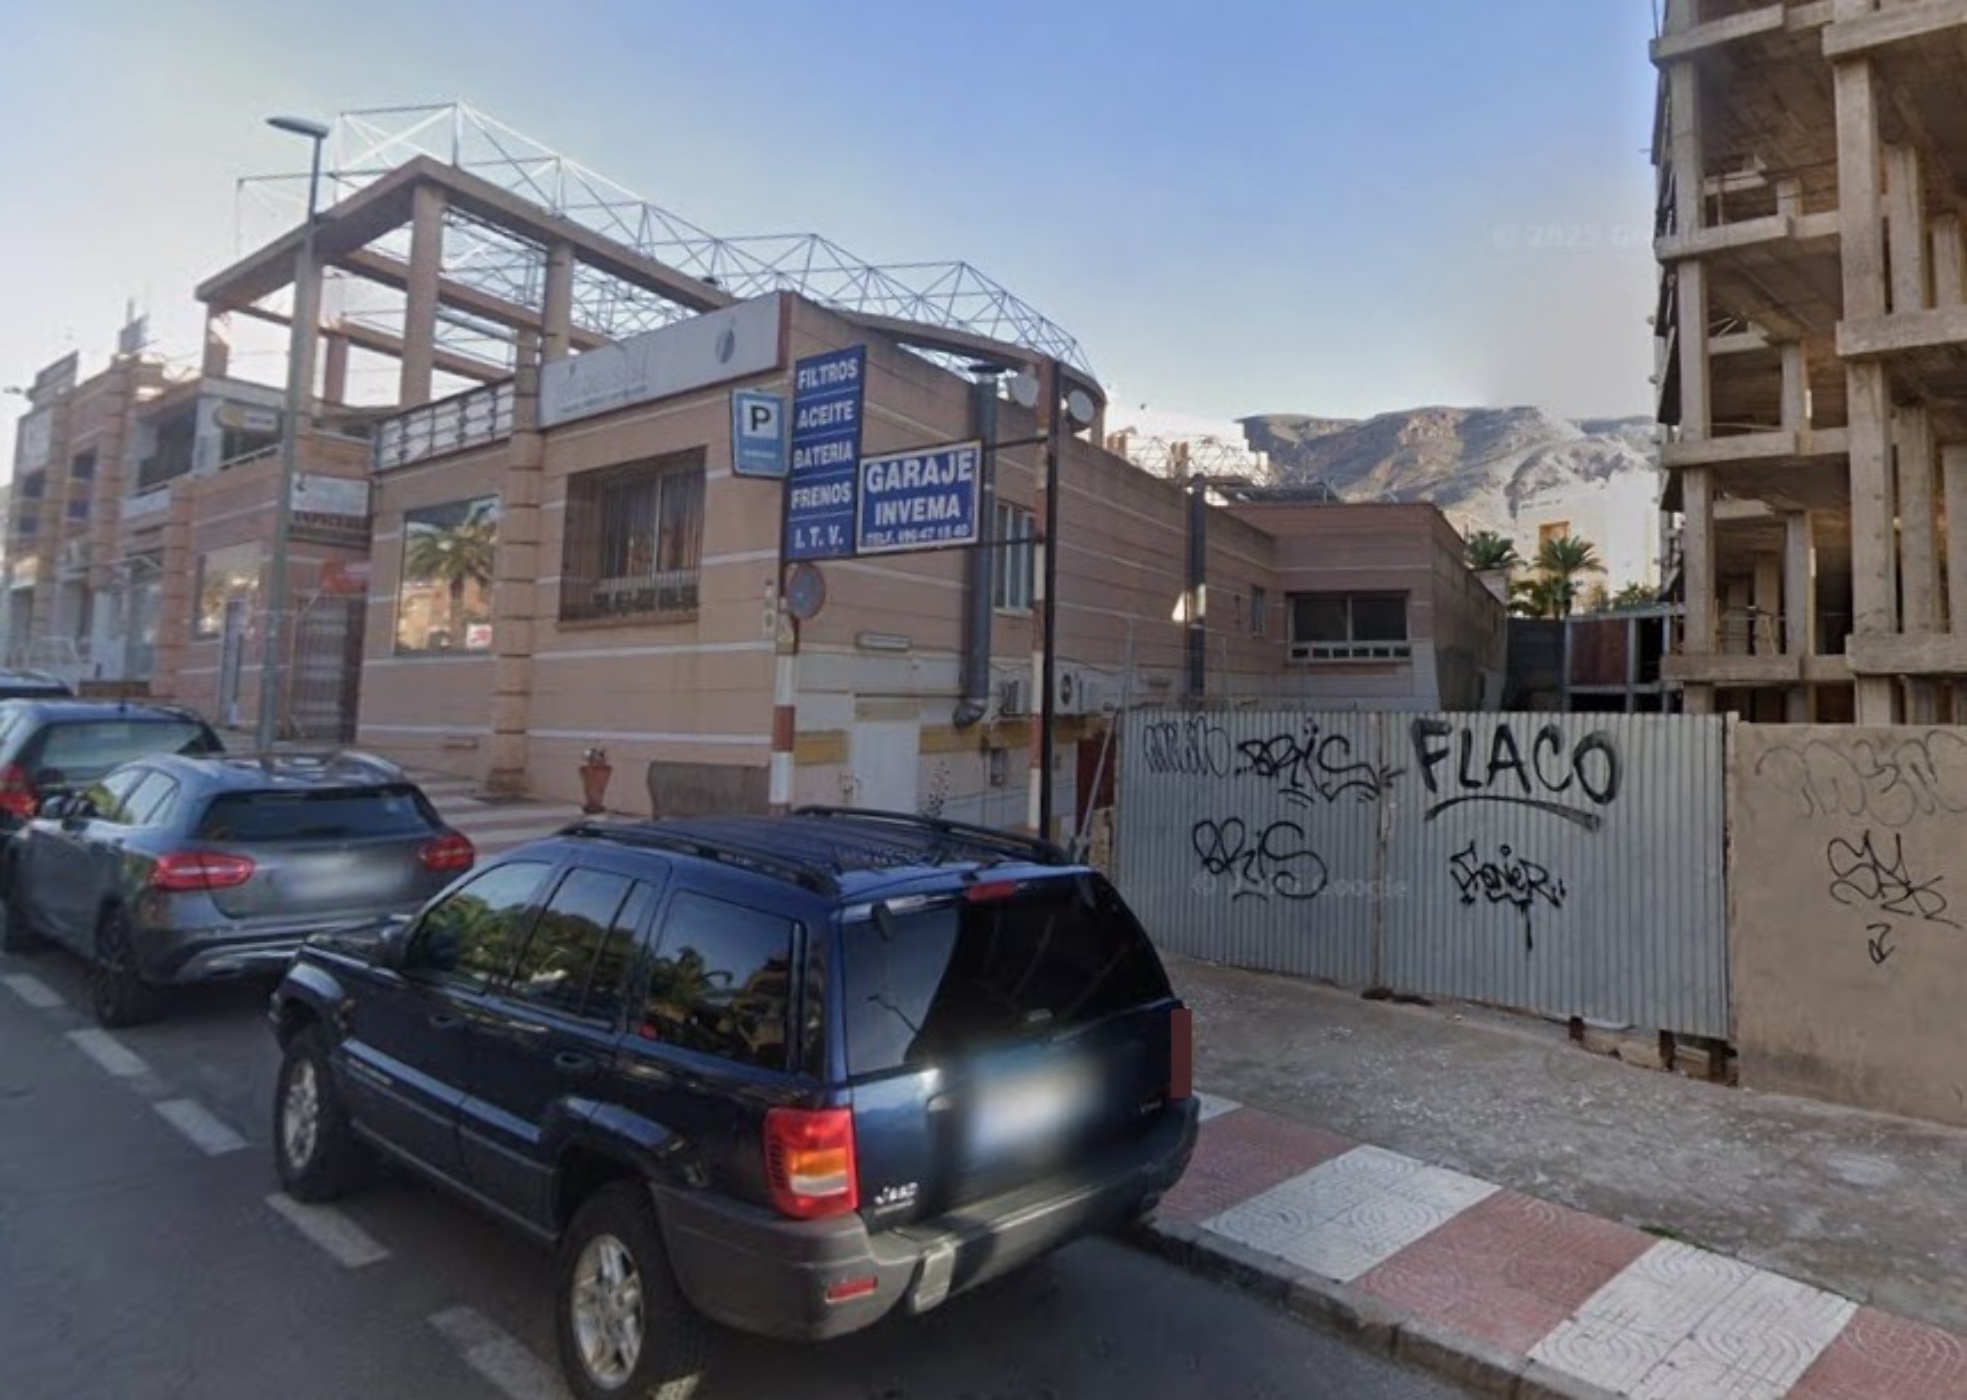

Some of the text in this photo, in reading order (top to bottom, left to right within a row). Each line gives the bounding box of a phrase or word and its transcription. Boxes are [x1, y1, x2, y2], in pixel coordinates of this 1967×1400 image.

[798, 359, 858, 389] FILTROS
[751, 404, 771, 432] P
[797, 400, 854, 429] ACEITE
[793, 441, 853, 470] BATERIA
[866, 451, 973, 494] GARAJE
[791, 482, 851, 510] FRENOS
[875, 494, 961, 526] INVEMA
[1411, 718, 1622, 805] FLACO
